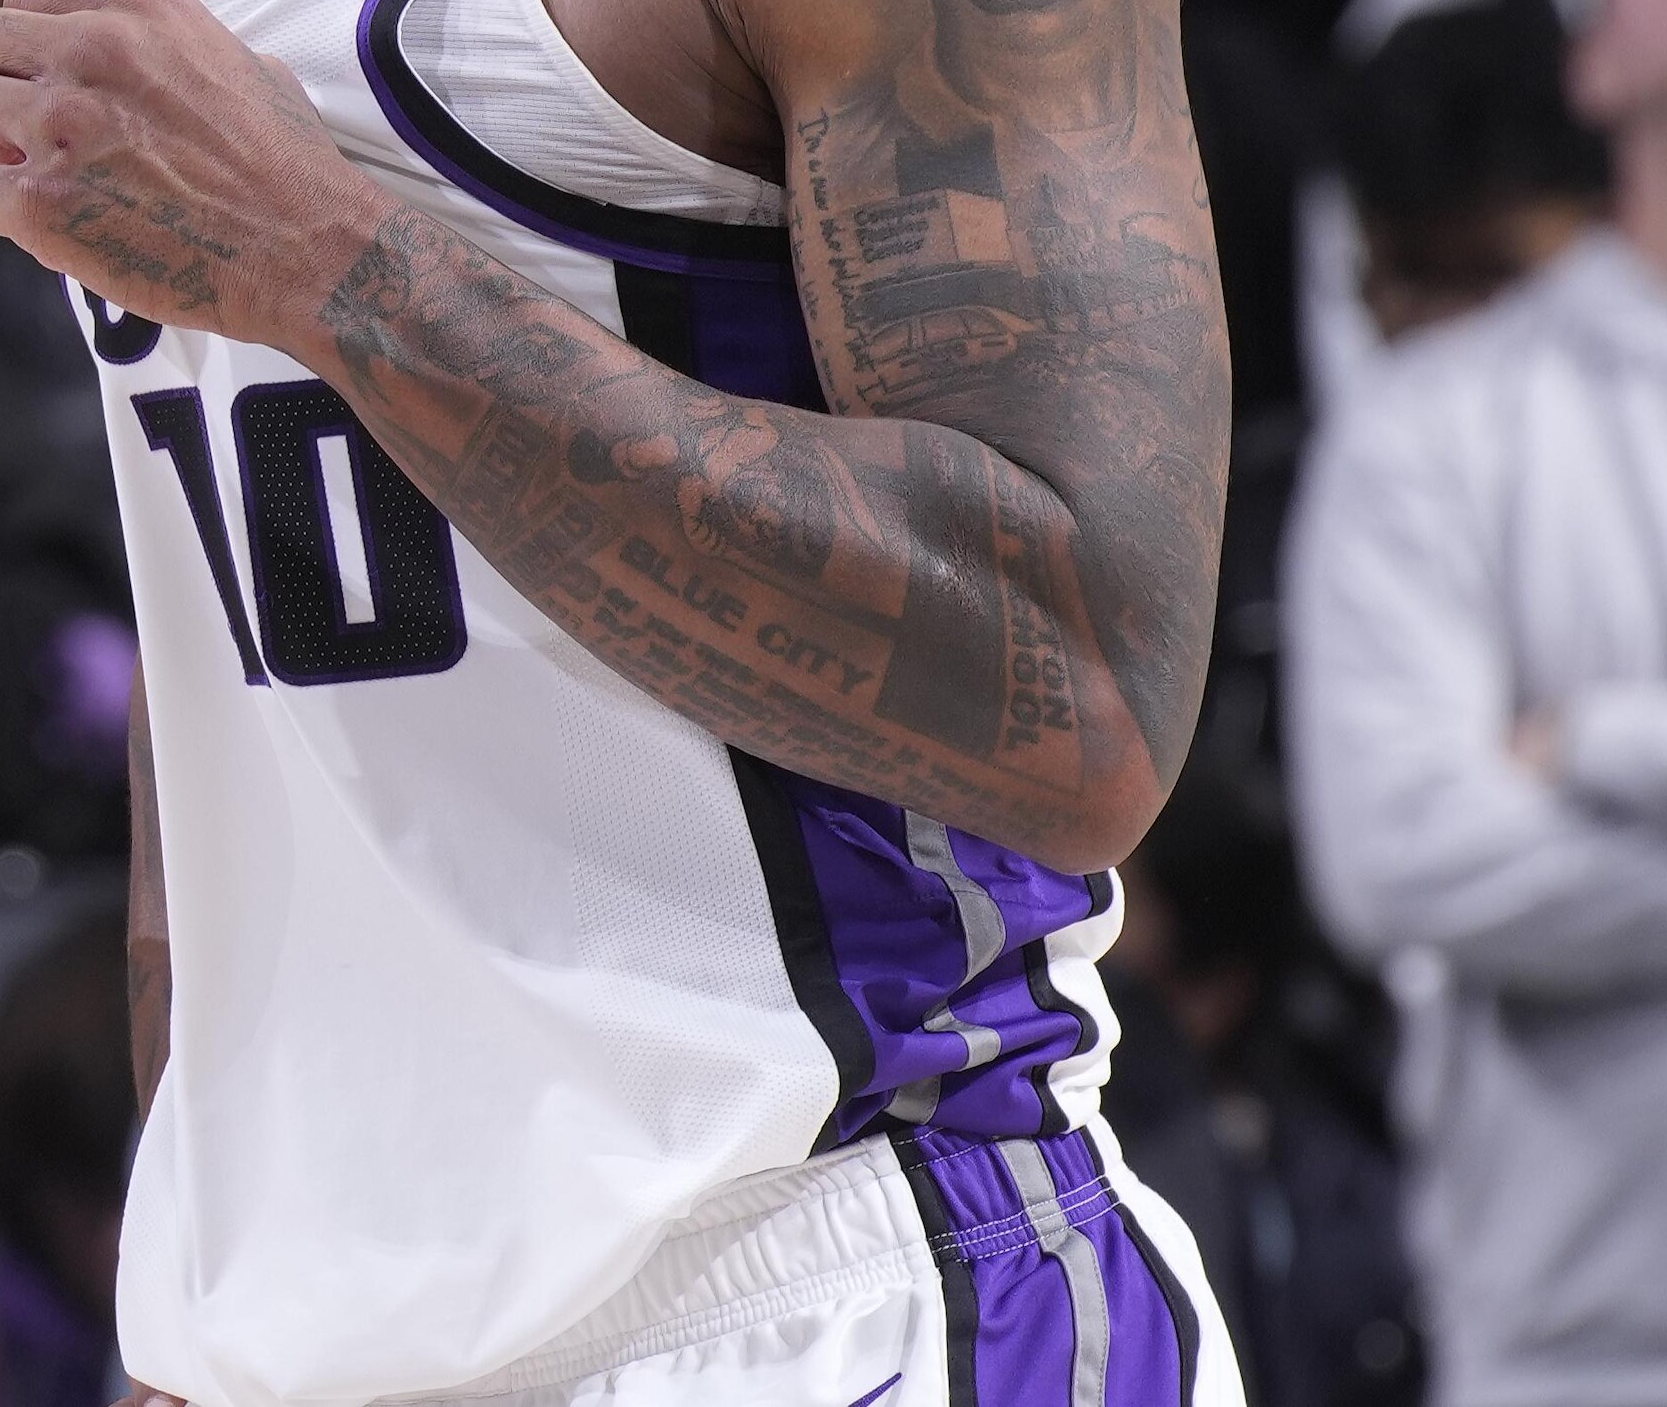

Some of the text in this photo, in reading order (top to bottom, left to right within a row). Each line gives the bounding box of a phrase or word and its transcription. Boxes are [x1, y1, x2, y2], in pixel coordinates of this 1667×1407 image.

[130, 377, 468, 687] 10
[620, 537, 750, 632] BLUE
[757, 621, 874, 693] CITY
